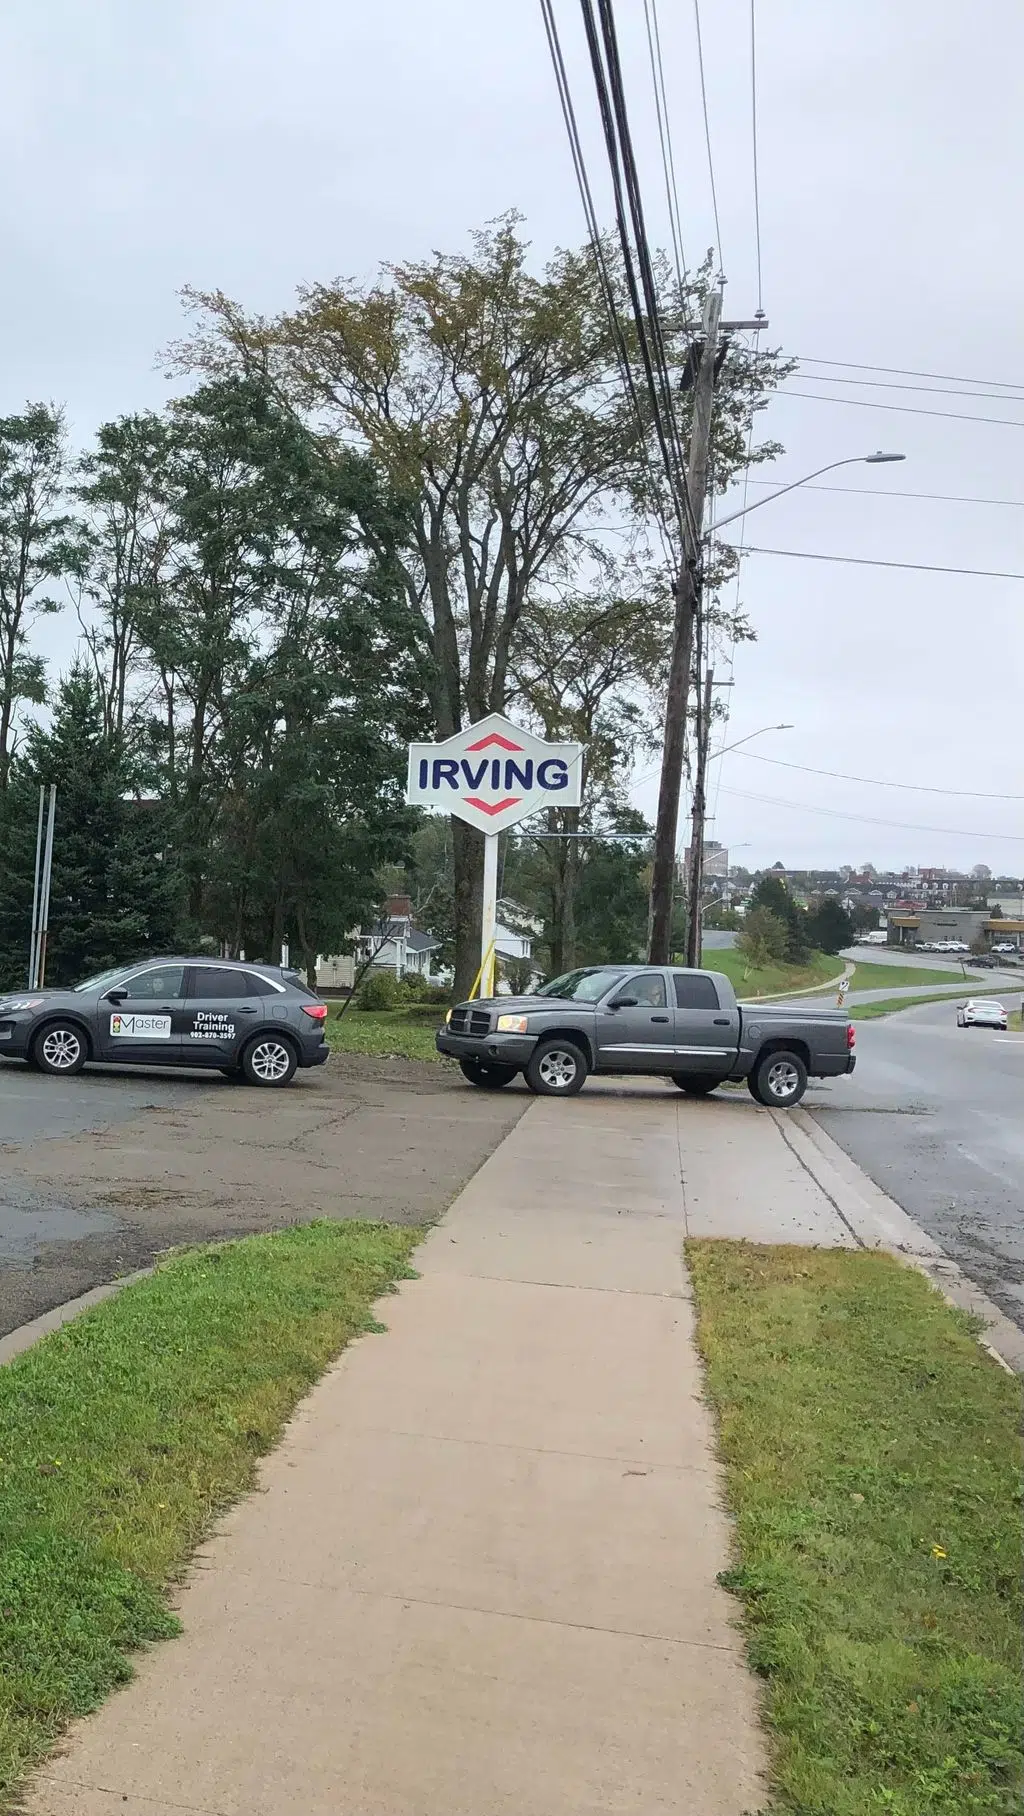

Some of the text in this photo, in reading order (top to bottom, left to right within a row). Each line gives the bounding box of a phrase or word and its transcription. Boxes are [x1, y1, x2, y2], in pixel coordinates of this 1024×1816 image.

[419, 758, 568, 790] IRVING
[197, 1012, 228, 1022] Driver
[119, 1016, 168, 1033] Master
[193, 1021, 234, 1032] Training
